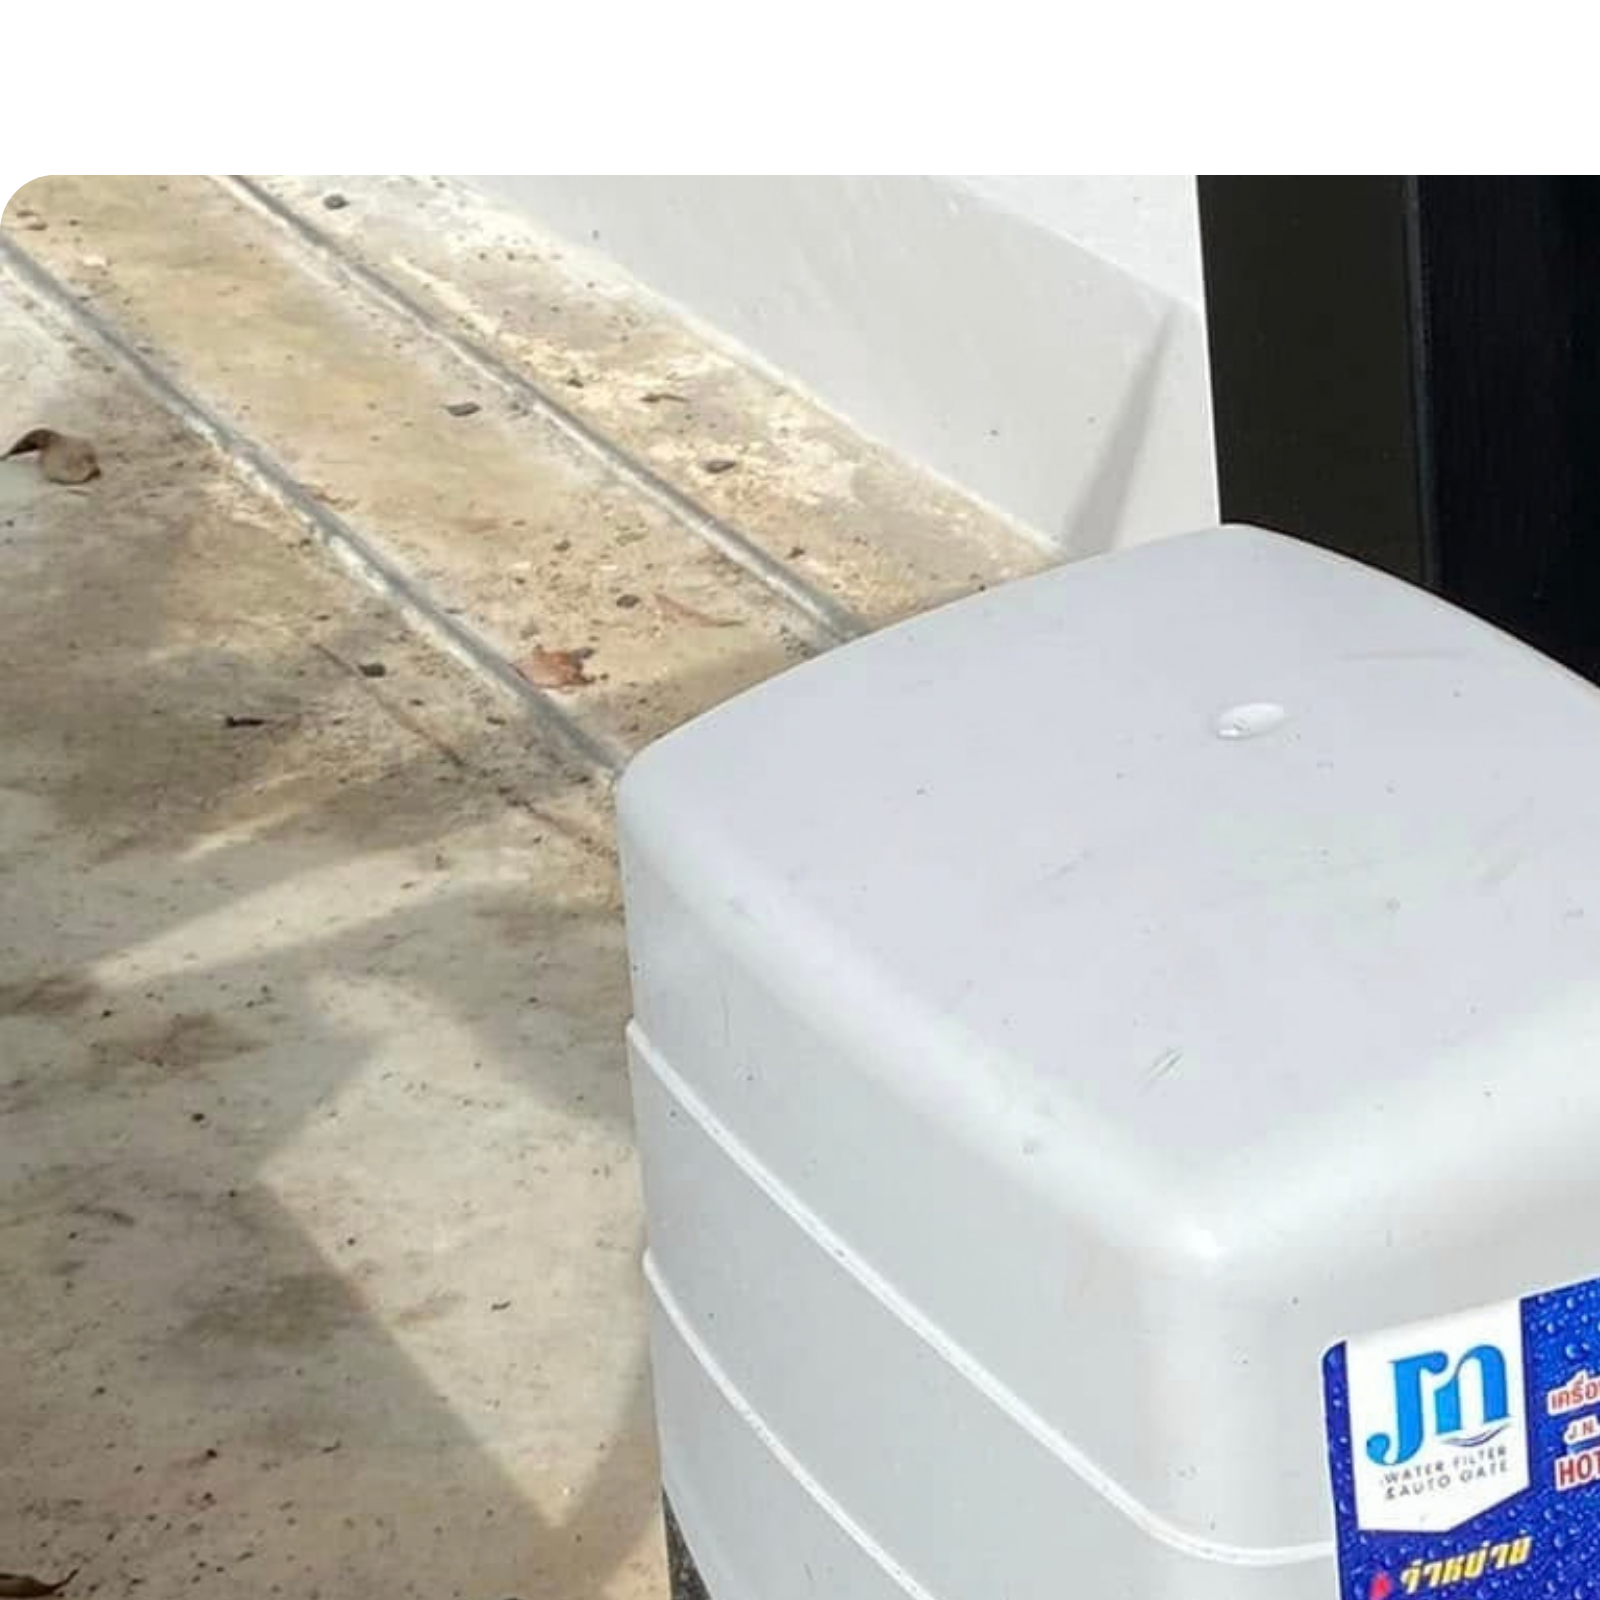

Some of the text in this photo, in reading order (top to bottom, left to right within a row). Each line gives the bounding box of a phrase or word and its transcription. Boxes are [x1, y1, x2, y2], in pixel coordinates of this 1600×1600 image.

[1384, 1446, 1507, 1484] WATER FILTER
[1460, 1462, 1507, 1482] GATE
[1401, 1536, 1532, 1594] จำหน่าย
